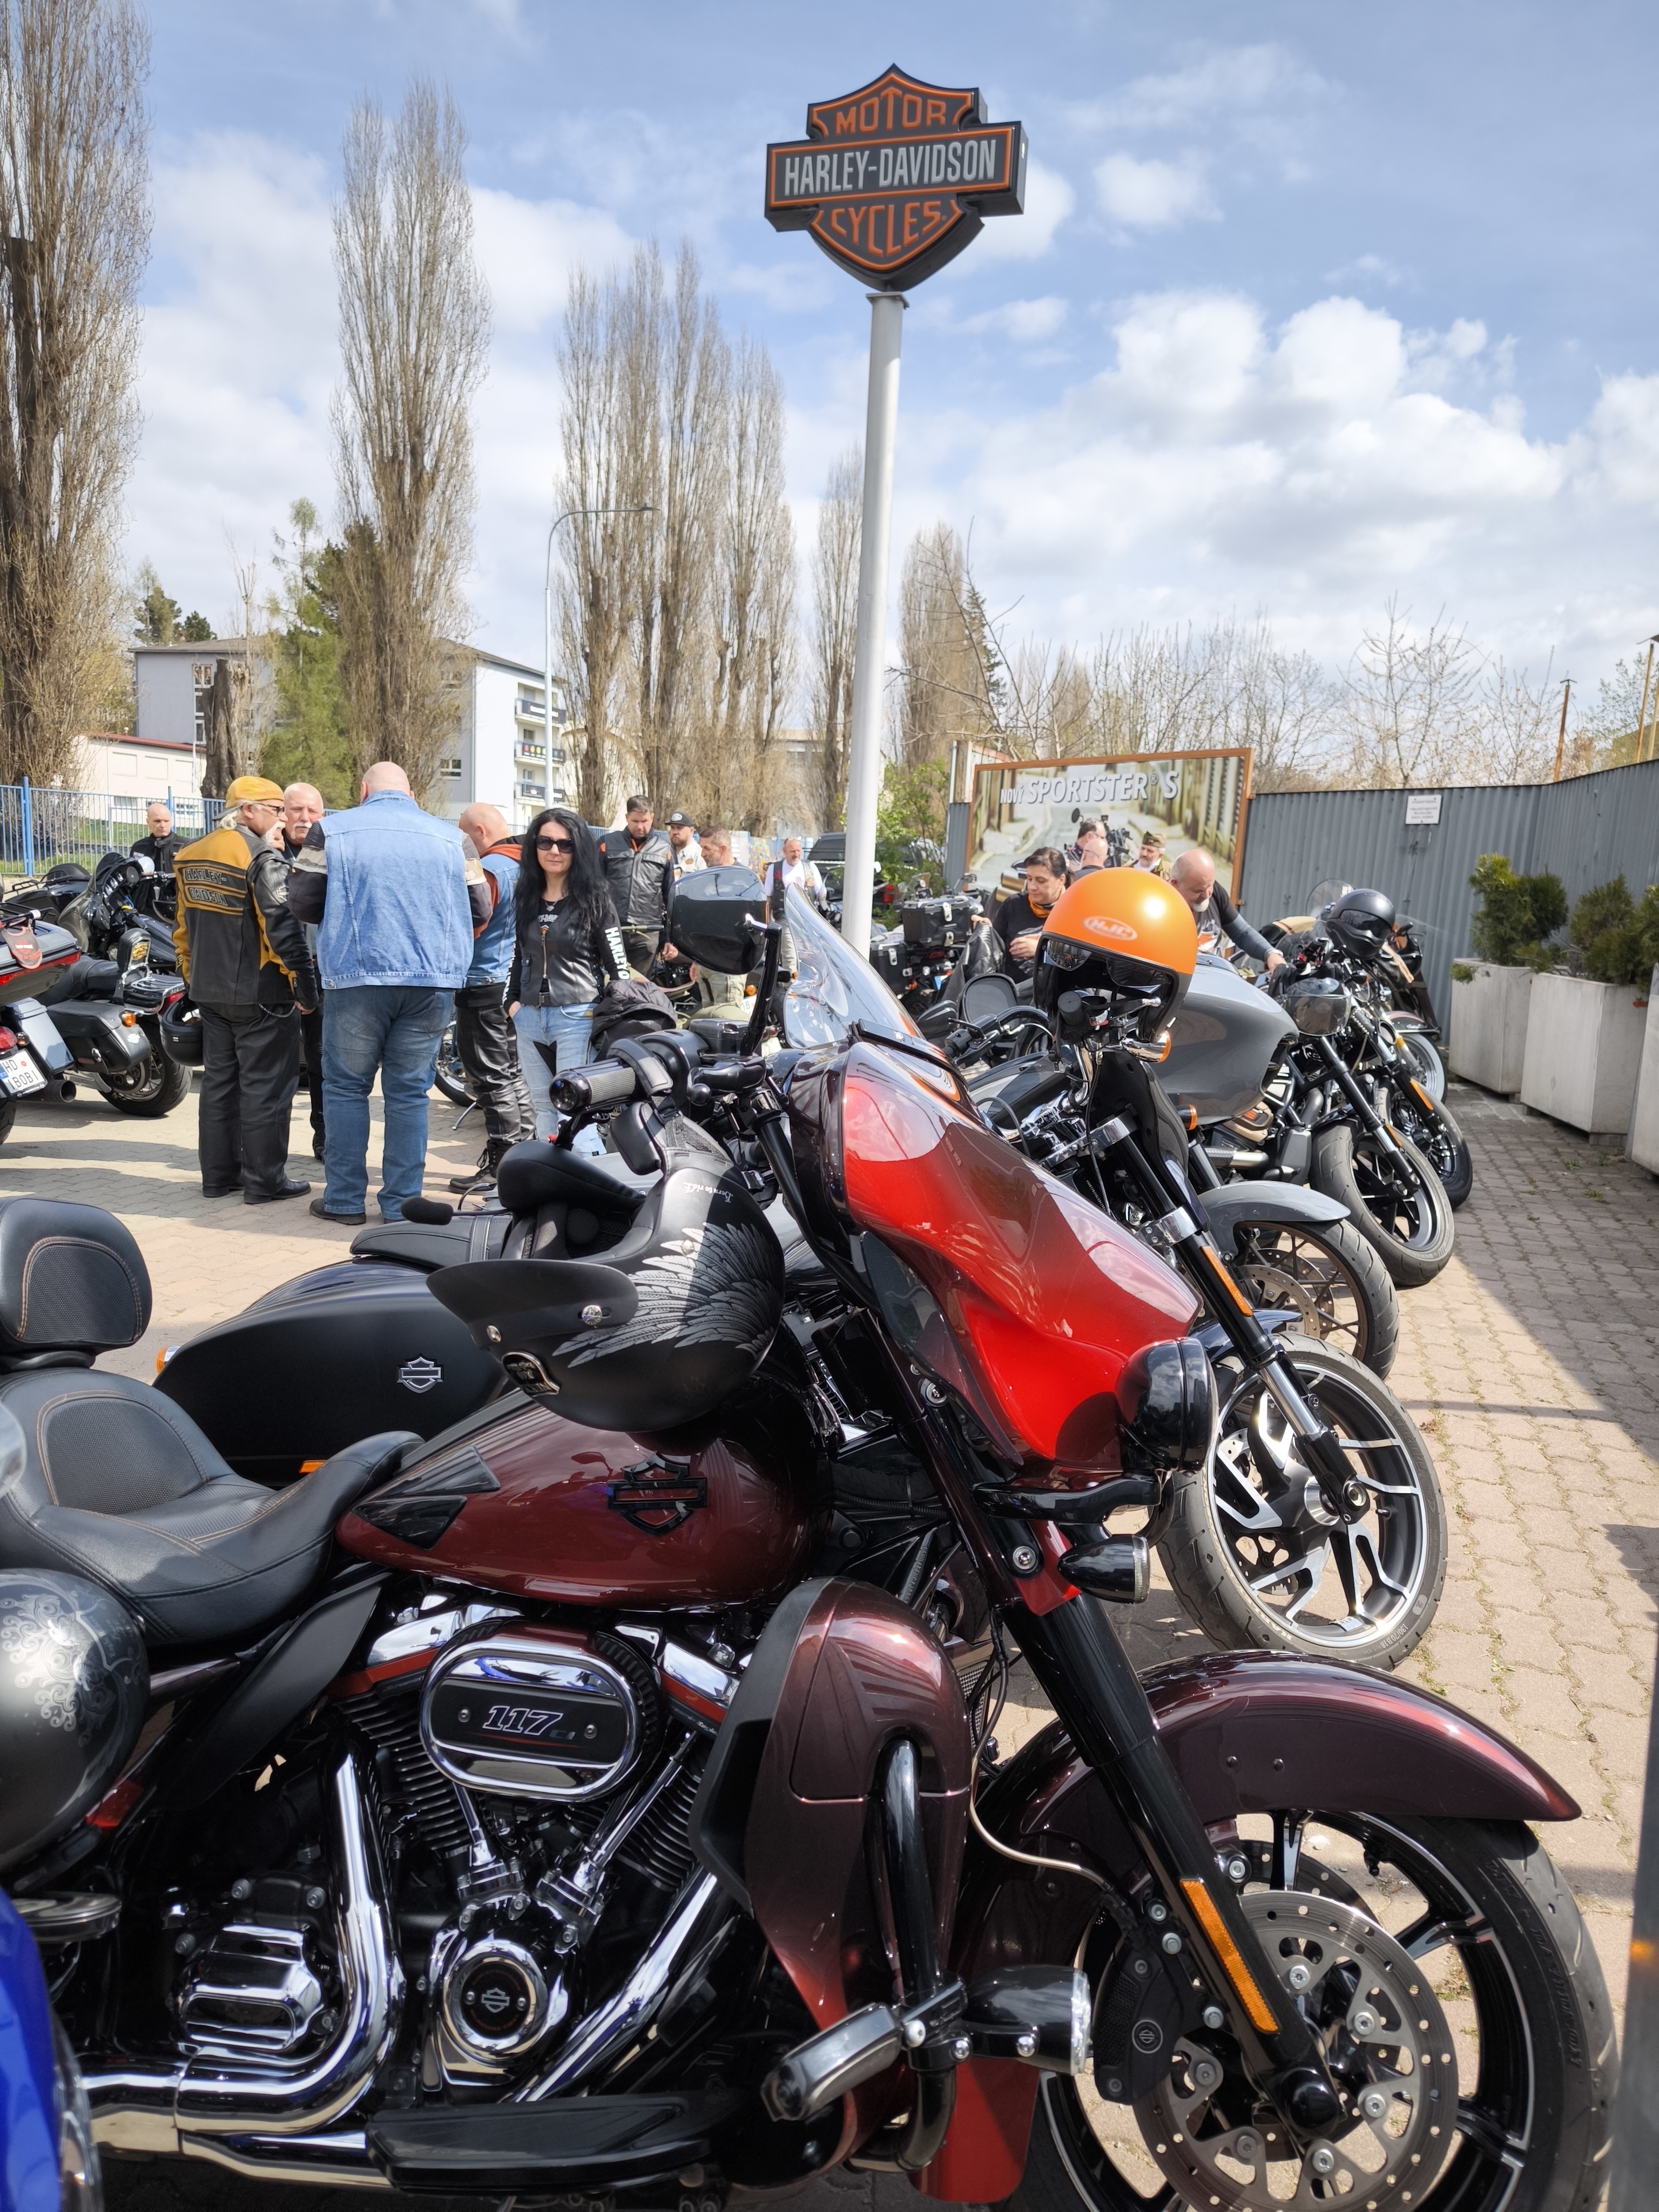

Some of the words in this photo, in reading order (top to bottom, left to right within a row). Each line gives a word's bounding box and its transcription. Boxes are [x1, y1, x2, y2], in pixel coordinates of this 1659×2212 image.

[835, 86, 947, 137] MOTOR
[784, 139, 997, 196] HARLEY-DAVIDSON
[830, 200, 942, 257] CYCLES
[1000, 786, 1025, 804] NOVÝ
[1163, 771, 1179, 799] S
[1089, 918, 1132, 938] HJC
[2, 1060, 18, 1073] HD
[482, 1705, 564, 1736] 117
